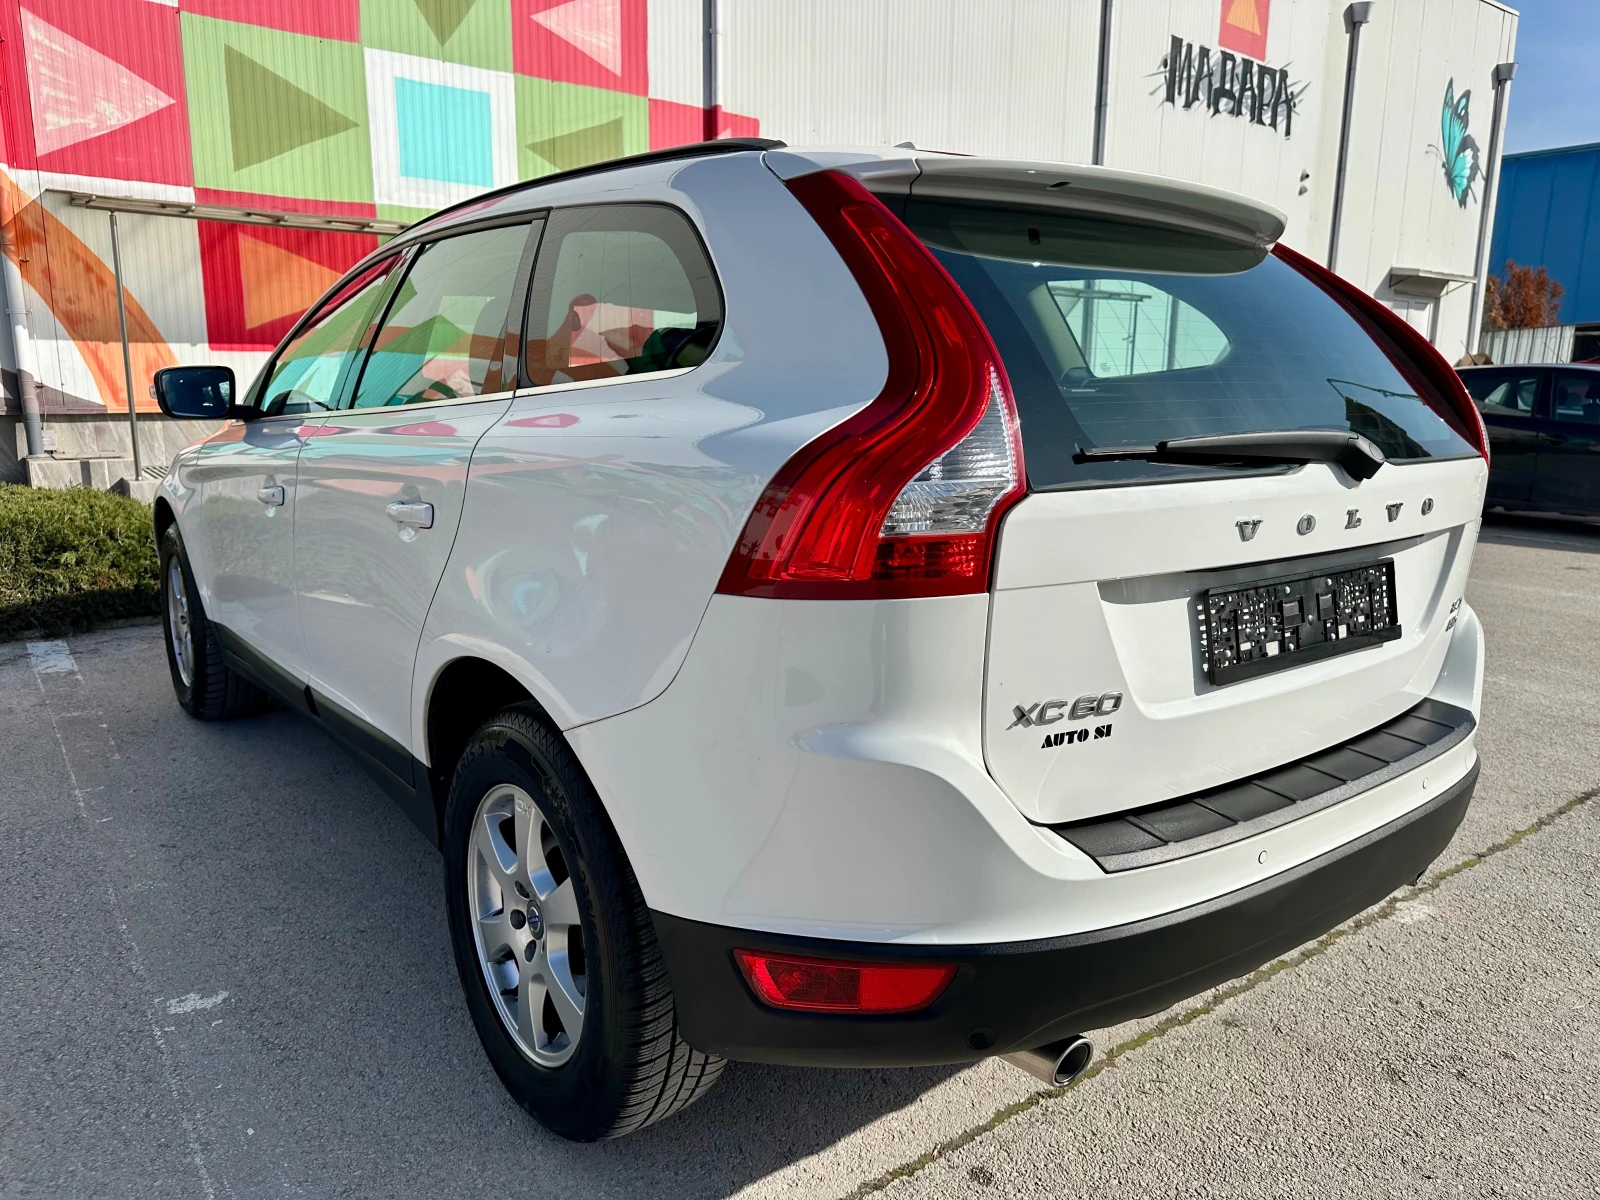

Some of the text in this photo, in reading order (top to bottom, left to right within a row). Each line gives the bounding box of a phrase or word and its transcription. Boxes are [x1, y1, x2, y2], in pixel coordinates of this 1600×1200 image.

[1163, 34, 1297, 139] МАДАРА
[1235, 497, 1434, 542] VOLVO
[1005, 691, 1123, 731] XC60
[1041, 723, 1112, 749] AUTO SI
